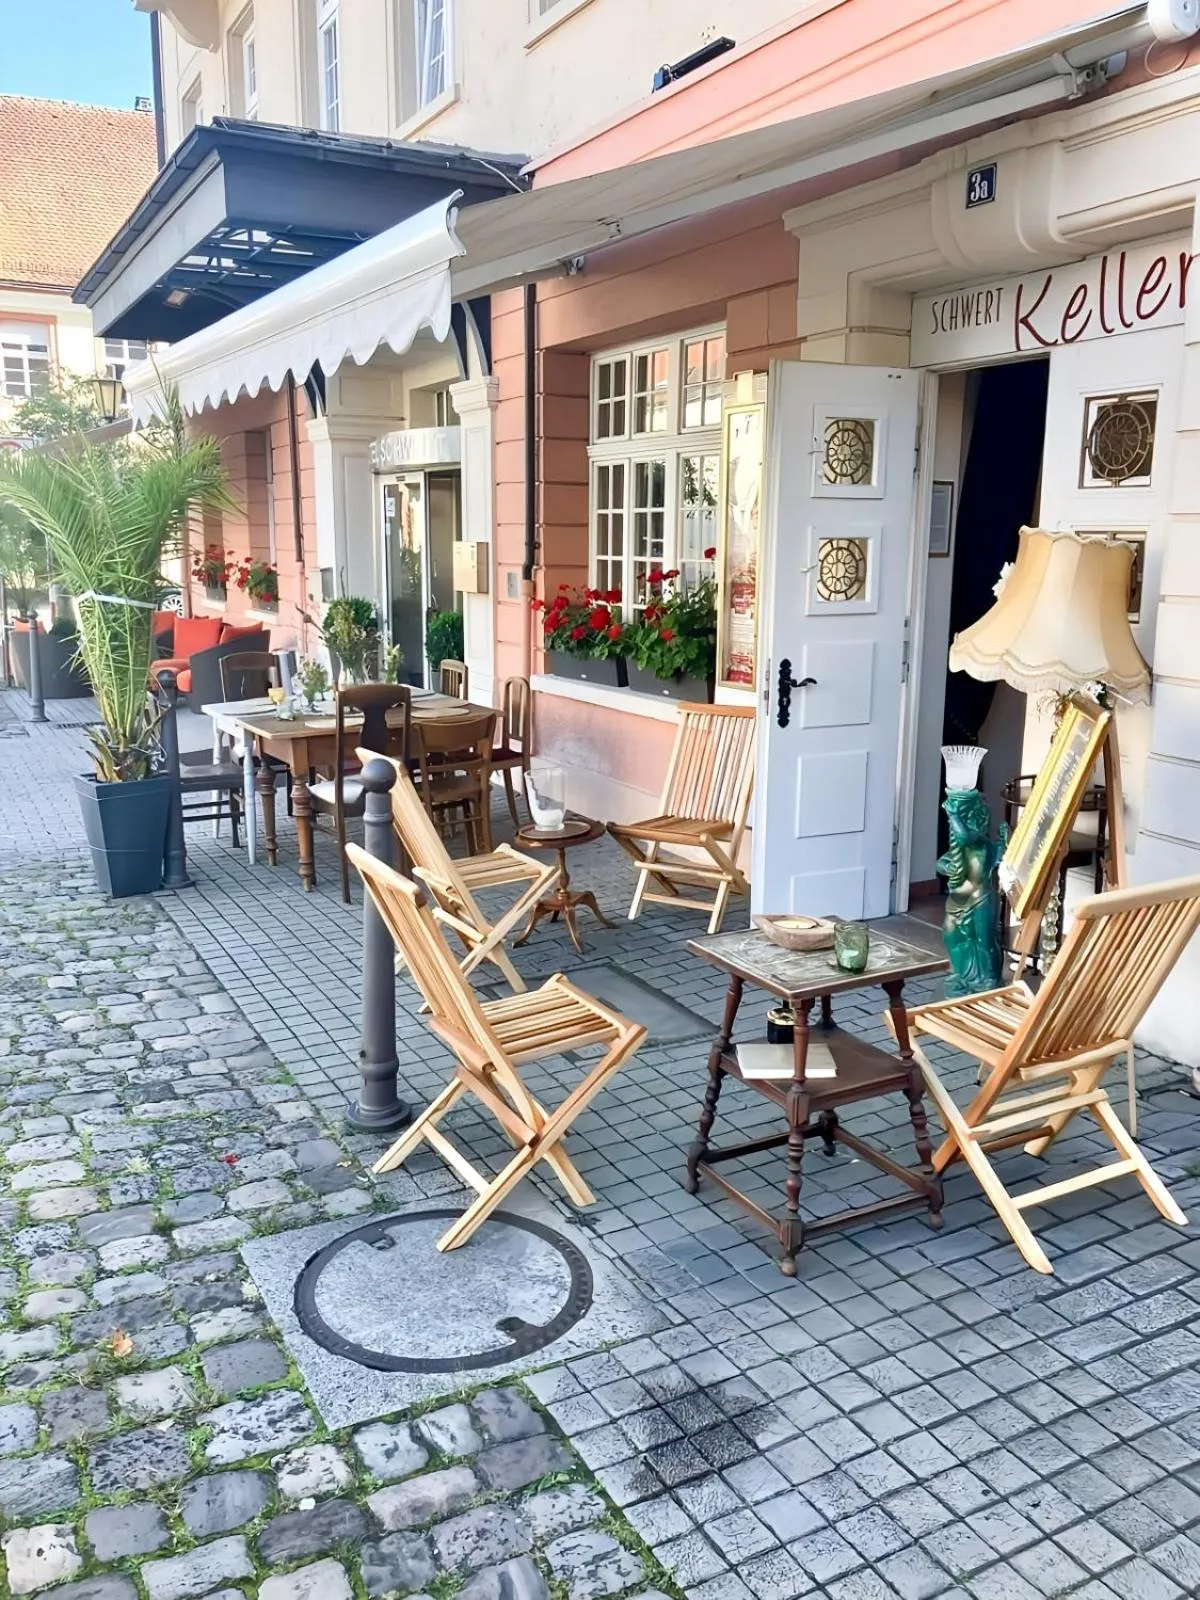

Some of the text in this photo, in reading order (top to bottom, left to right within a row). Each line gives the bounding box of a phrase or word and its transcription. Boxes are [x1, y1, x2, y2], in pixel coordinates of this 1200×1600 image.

[970, 173, 989, 202] 3a
[931, 251, 1194, 351] SCHWERT Keller
